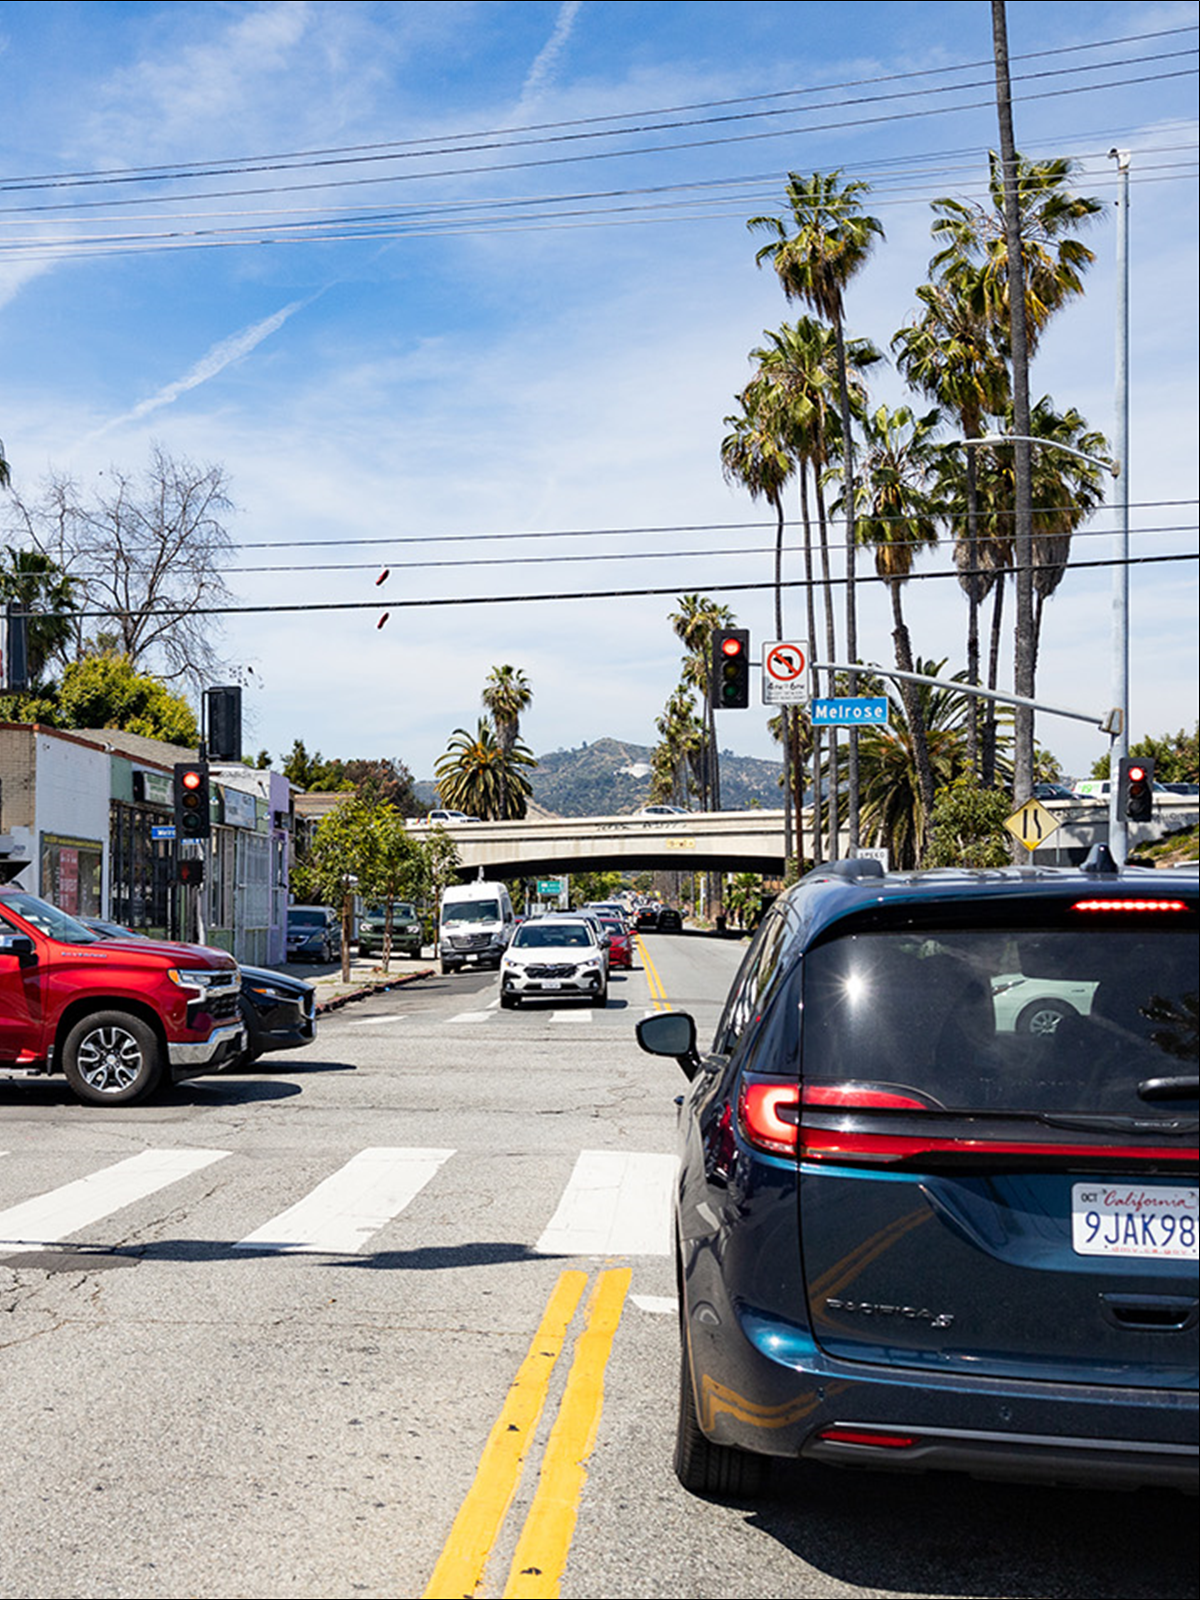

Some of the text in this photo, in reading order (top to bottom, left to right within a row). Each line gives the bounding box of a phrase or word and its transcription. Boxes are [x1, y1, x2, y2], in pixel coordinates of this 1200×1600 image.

[815, 705, 883, 719] Melrose
[1081, 1189, 1196, 1213] OCT California
[1085, 1211, 1200, 1248] 9JAK98
